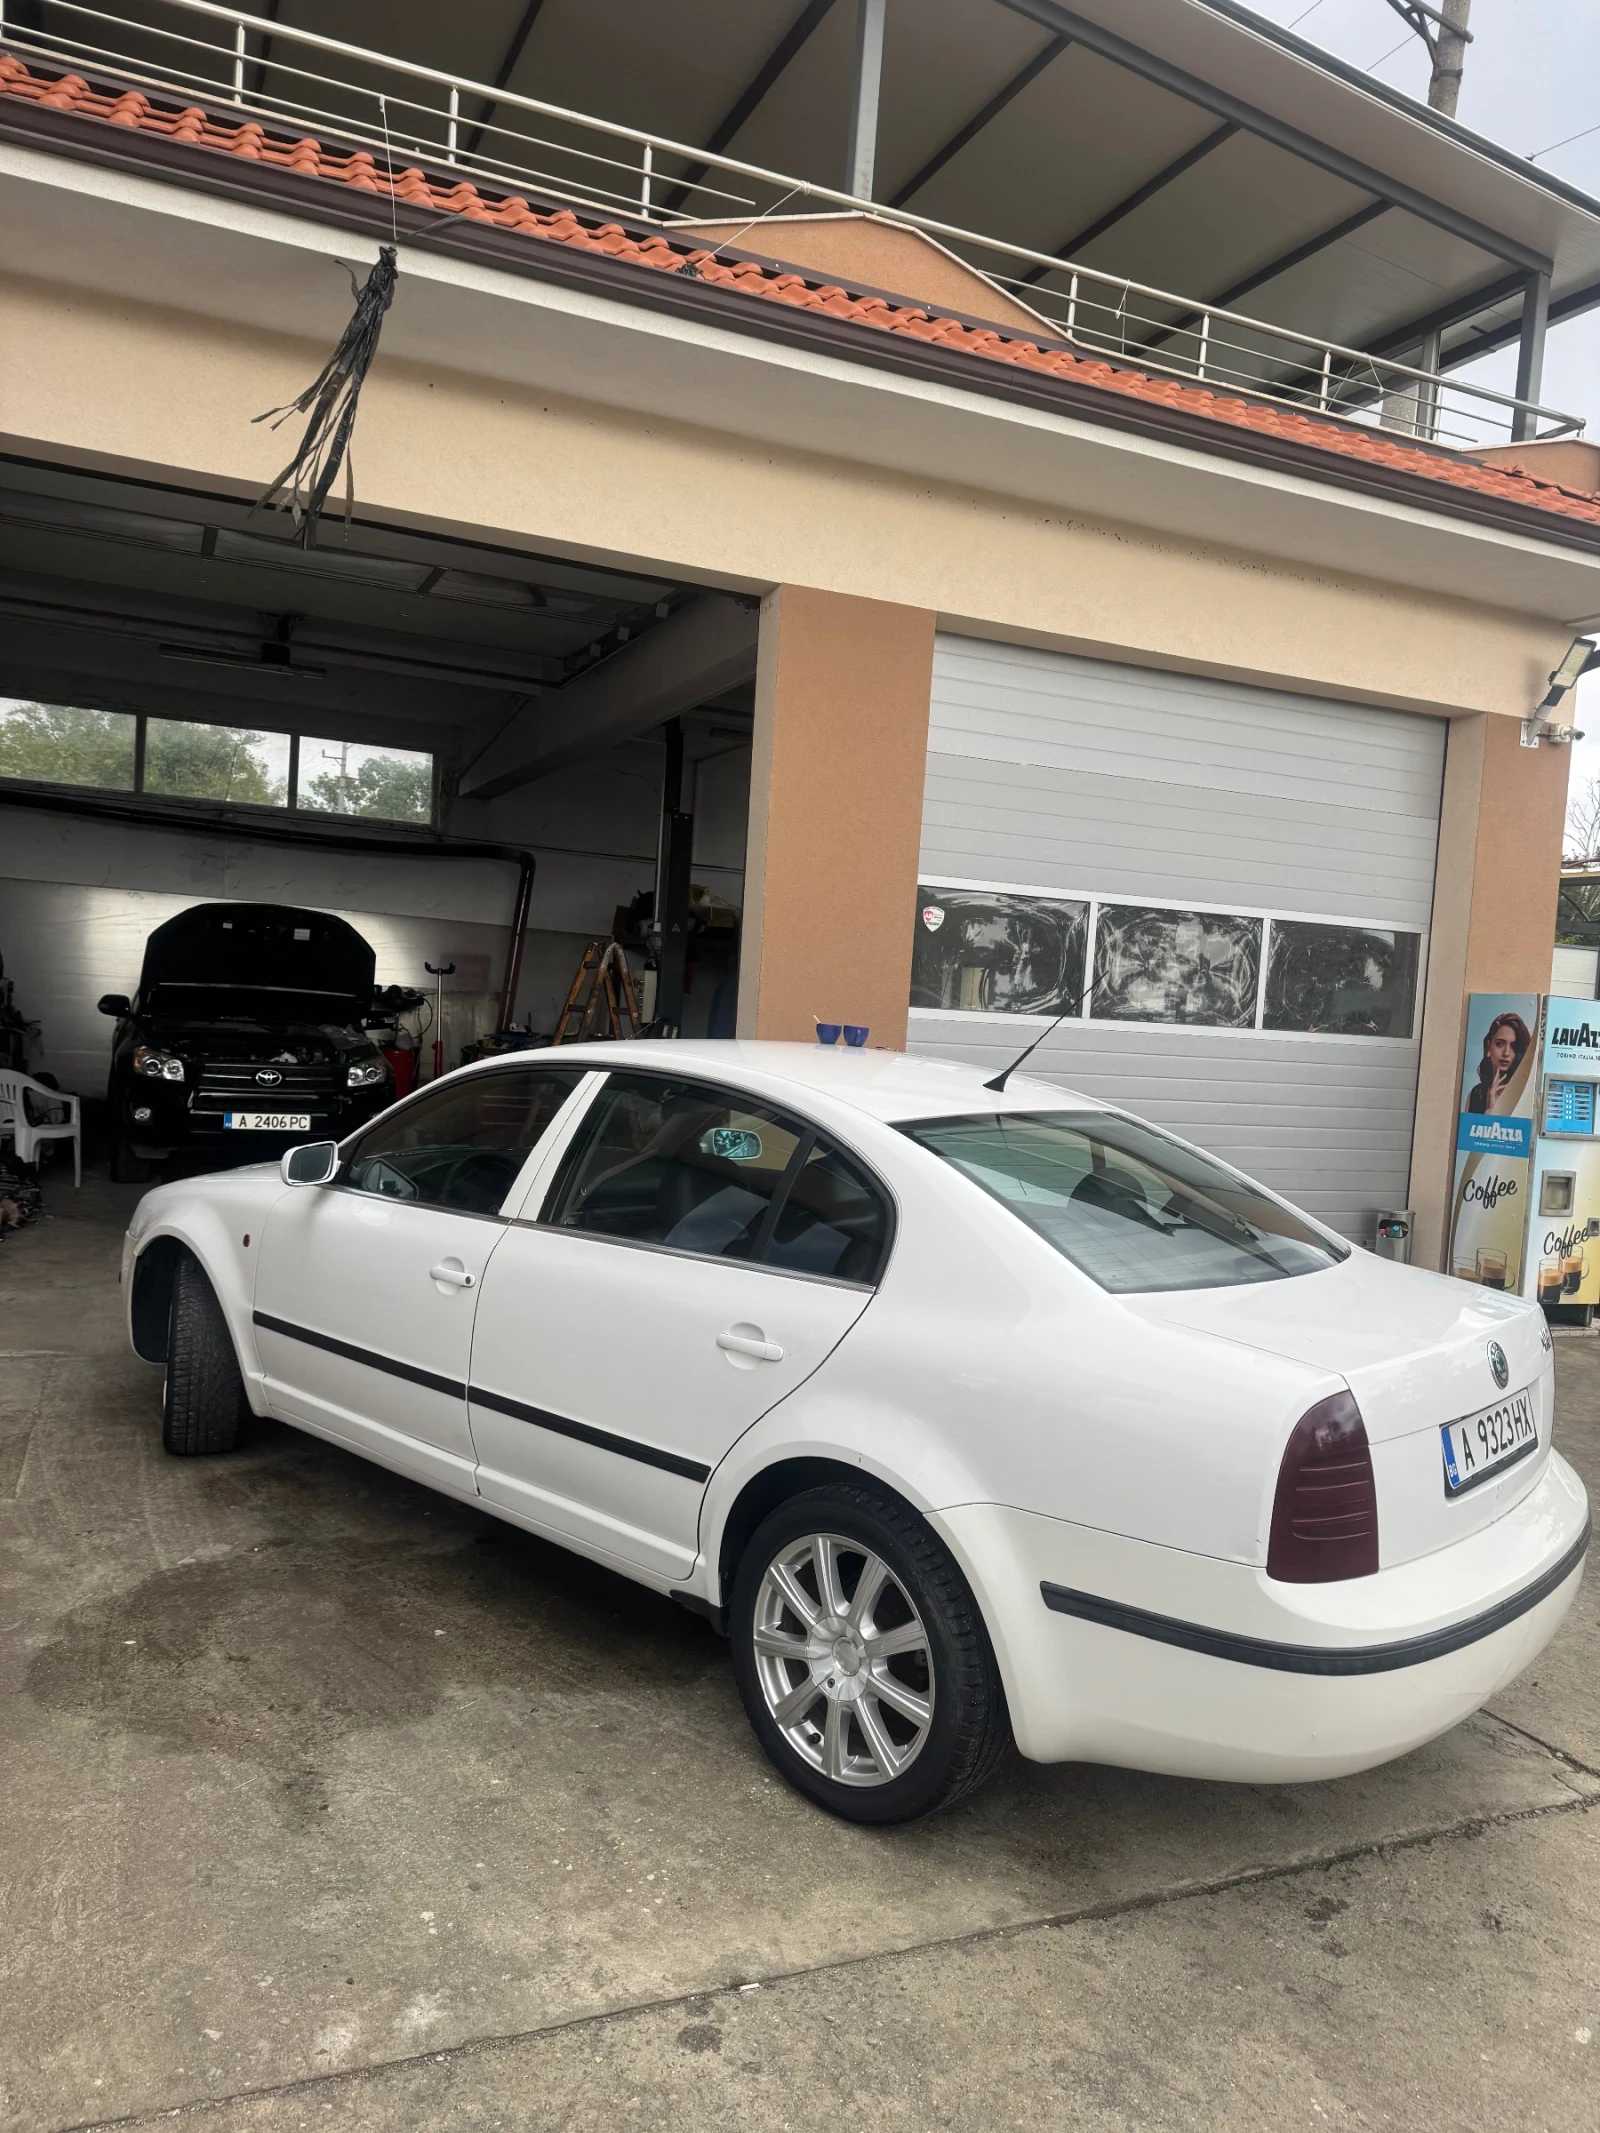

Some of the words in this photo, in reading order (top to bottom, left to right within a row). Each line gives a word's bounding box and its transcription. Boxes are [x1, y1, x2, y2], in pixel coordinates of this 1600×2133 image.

[1551, 1022, 1600, 1048] LAVAZ
[239, 1115, 247, 1127] A
[1469, 1122, 1523, 1142] LAVAZZA
[1463, 1175, 1518, 1209] Coffee
[1543, 1224, 1591, 1259] Coffee
[1449, 1463, 1458, 1478] BG
[1461, 1427, 1475, 1471] A
